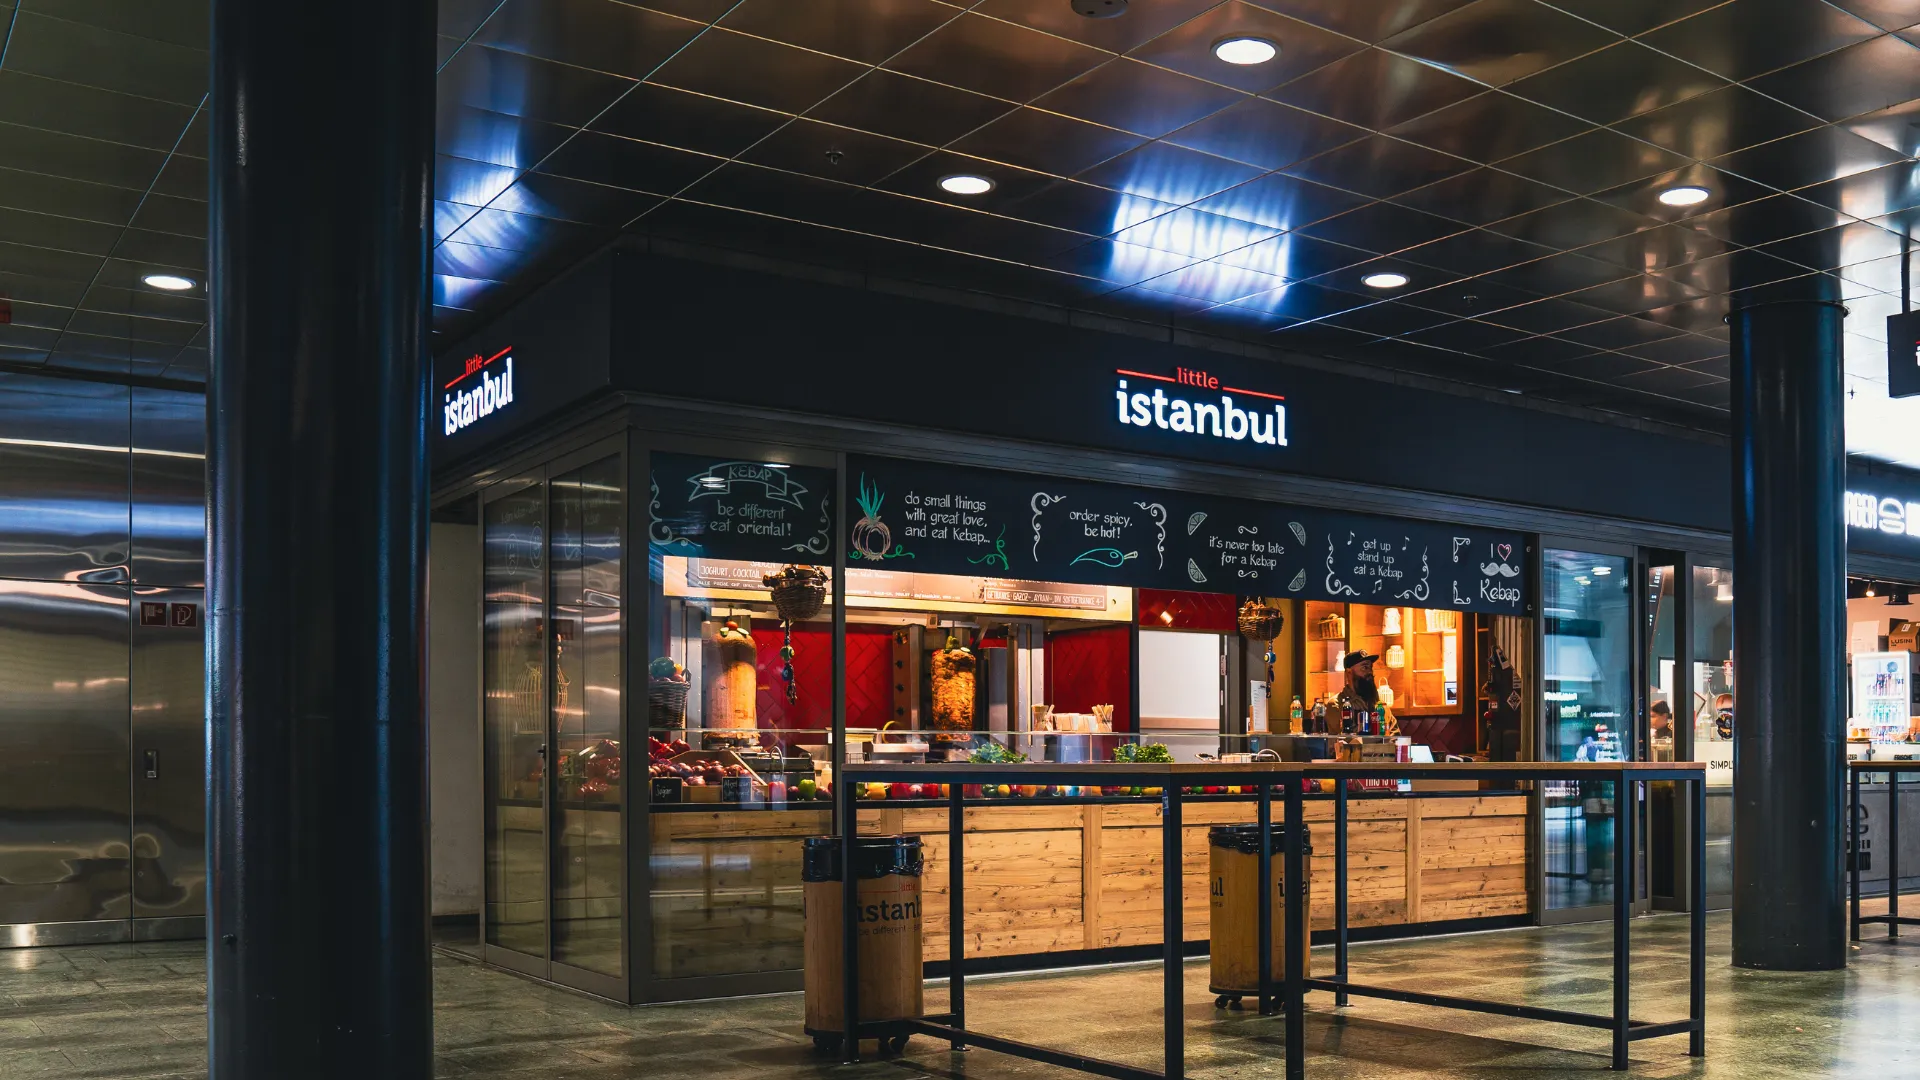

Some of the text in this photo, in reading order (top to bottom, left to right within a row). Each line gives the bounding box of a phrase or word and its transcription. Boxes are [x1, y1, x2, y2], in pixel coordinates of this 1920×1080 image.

[465, 353, 483, 376] little
[1177, 366, 1219, 389] little
[444, 356, 513, 436] istanbul
[1116, 379, 1288, 447] istanbul
[728, 465, 773, 481] KEBAP
[717, 499, 786, 520] be different
[904, 491, 987, 513] do small things
[905, 508, 988, 528] with great love,
[1069, 509, 1133, 528] order spicy,
[709, 520, 792, 537] eat oriental!
[905, 525, 927, 538] and
[931, 526, 949, 539] eat
[1084, 526, 1121, 539] be hot!
[1209, 536, 1285, 555] it's never too late
[1362, 539, 1391, 552] get up
[1489, 543, 1495, 559] I
[1220, 551, 1278, 571] for a Kebap
[1357, 551, 1395, 565] stand up
[1353, 565, 1404, 579] eat a Kebap
[1480, 578, 1521, 607] Kebap
[1710, 760, 1733, 770] SIMPL
